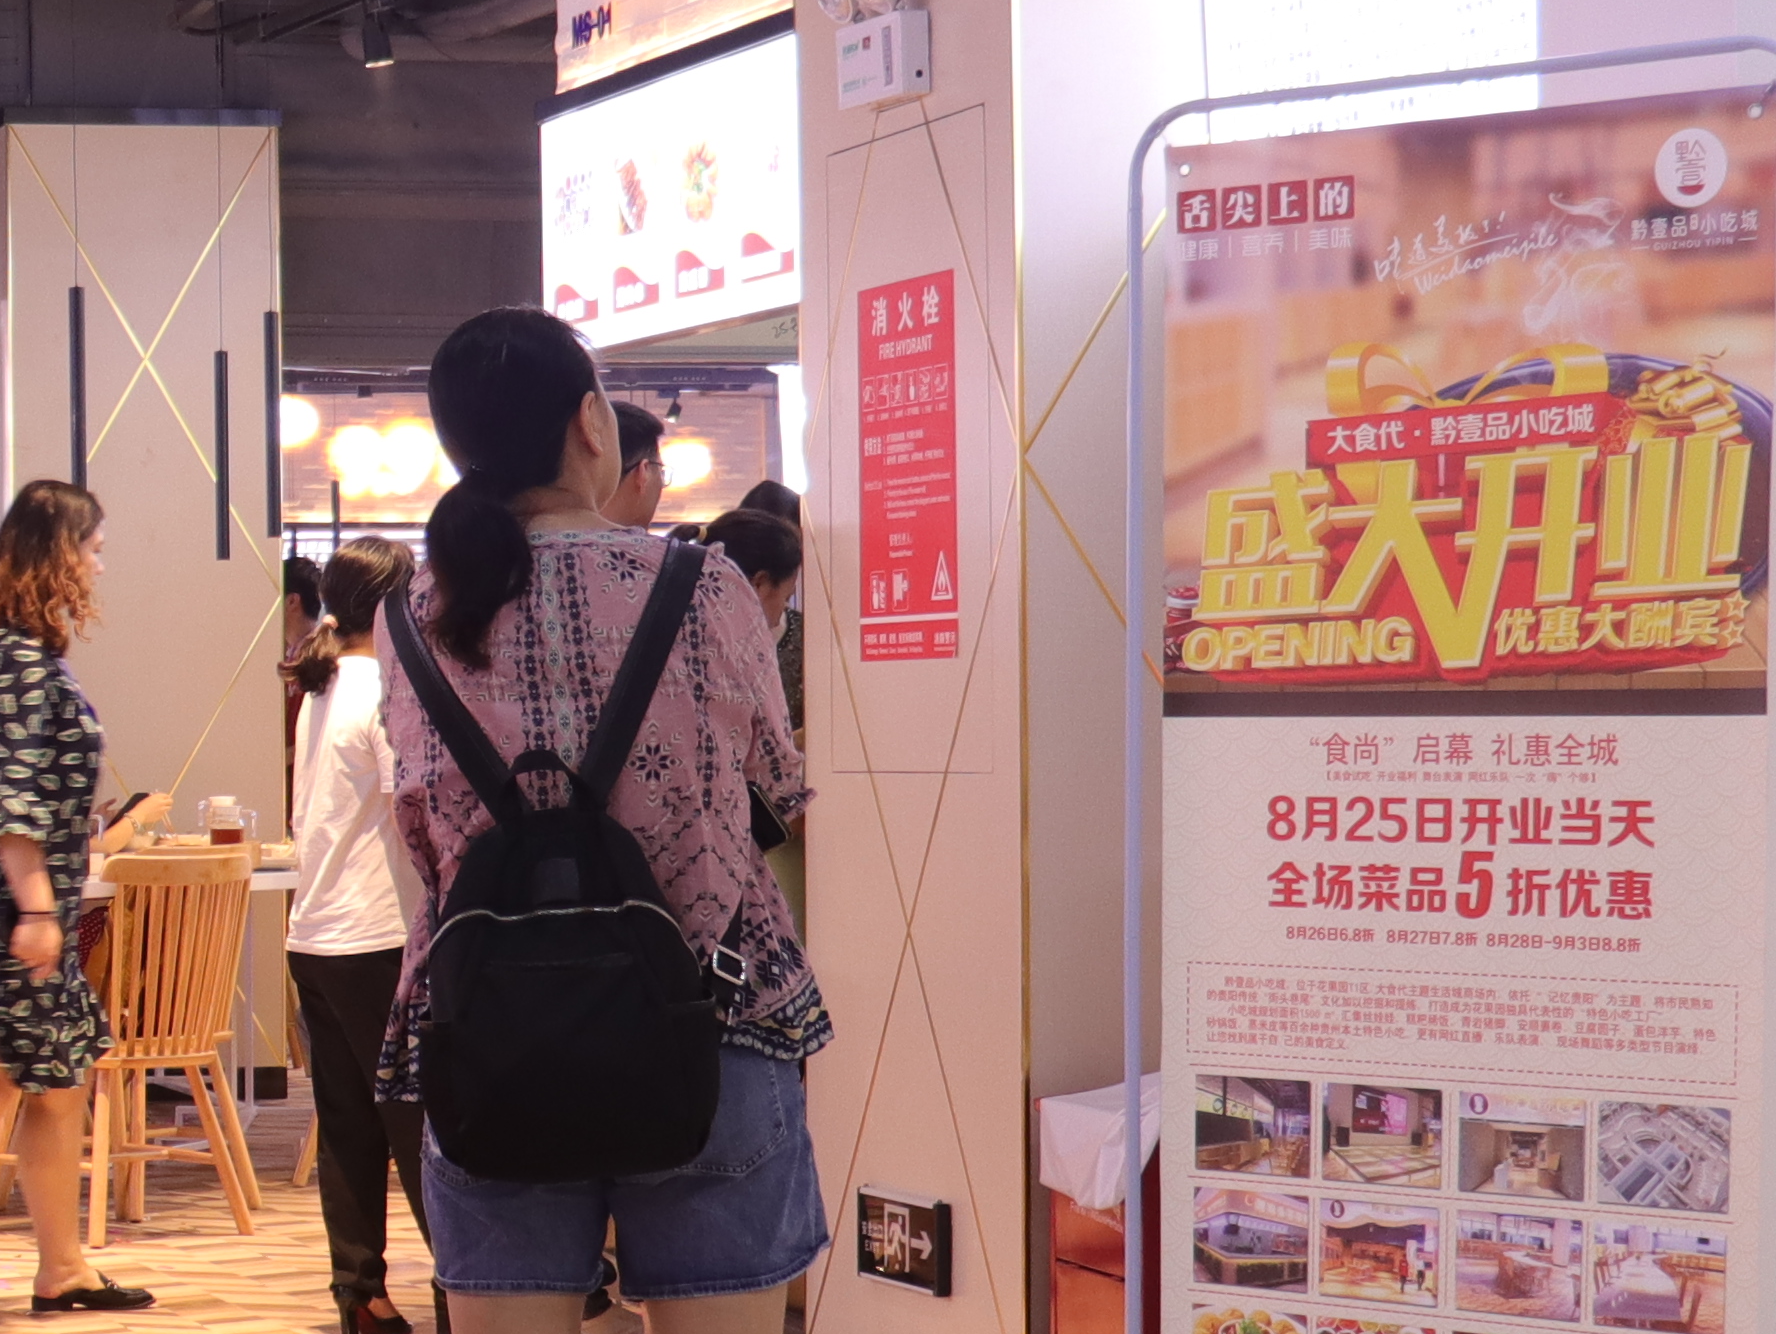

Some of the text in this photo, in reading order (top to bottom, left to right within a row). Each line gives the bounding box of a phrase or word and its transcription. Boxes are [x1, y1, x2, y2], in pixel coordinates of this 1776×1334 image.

[1180, 175, 1353, 231] 舌尖上的
[870, 285, 940, 337] 消火栓
[1194, 431, 1753, 669] 盛大开业
[1182, 618, 1416, 671] OPENING
[1493, 596, 1723, 656] 优惠大酬宾
[1309, 731, 1620, 767] “食尚” 启幕 礼惠全城
[1265, 795, 1656, 849] 8月25日开业当天
